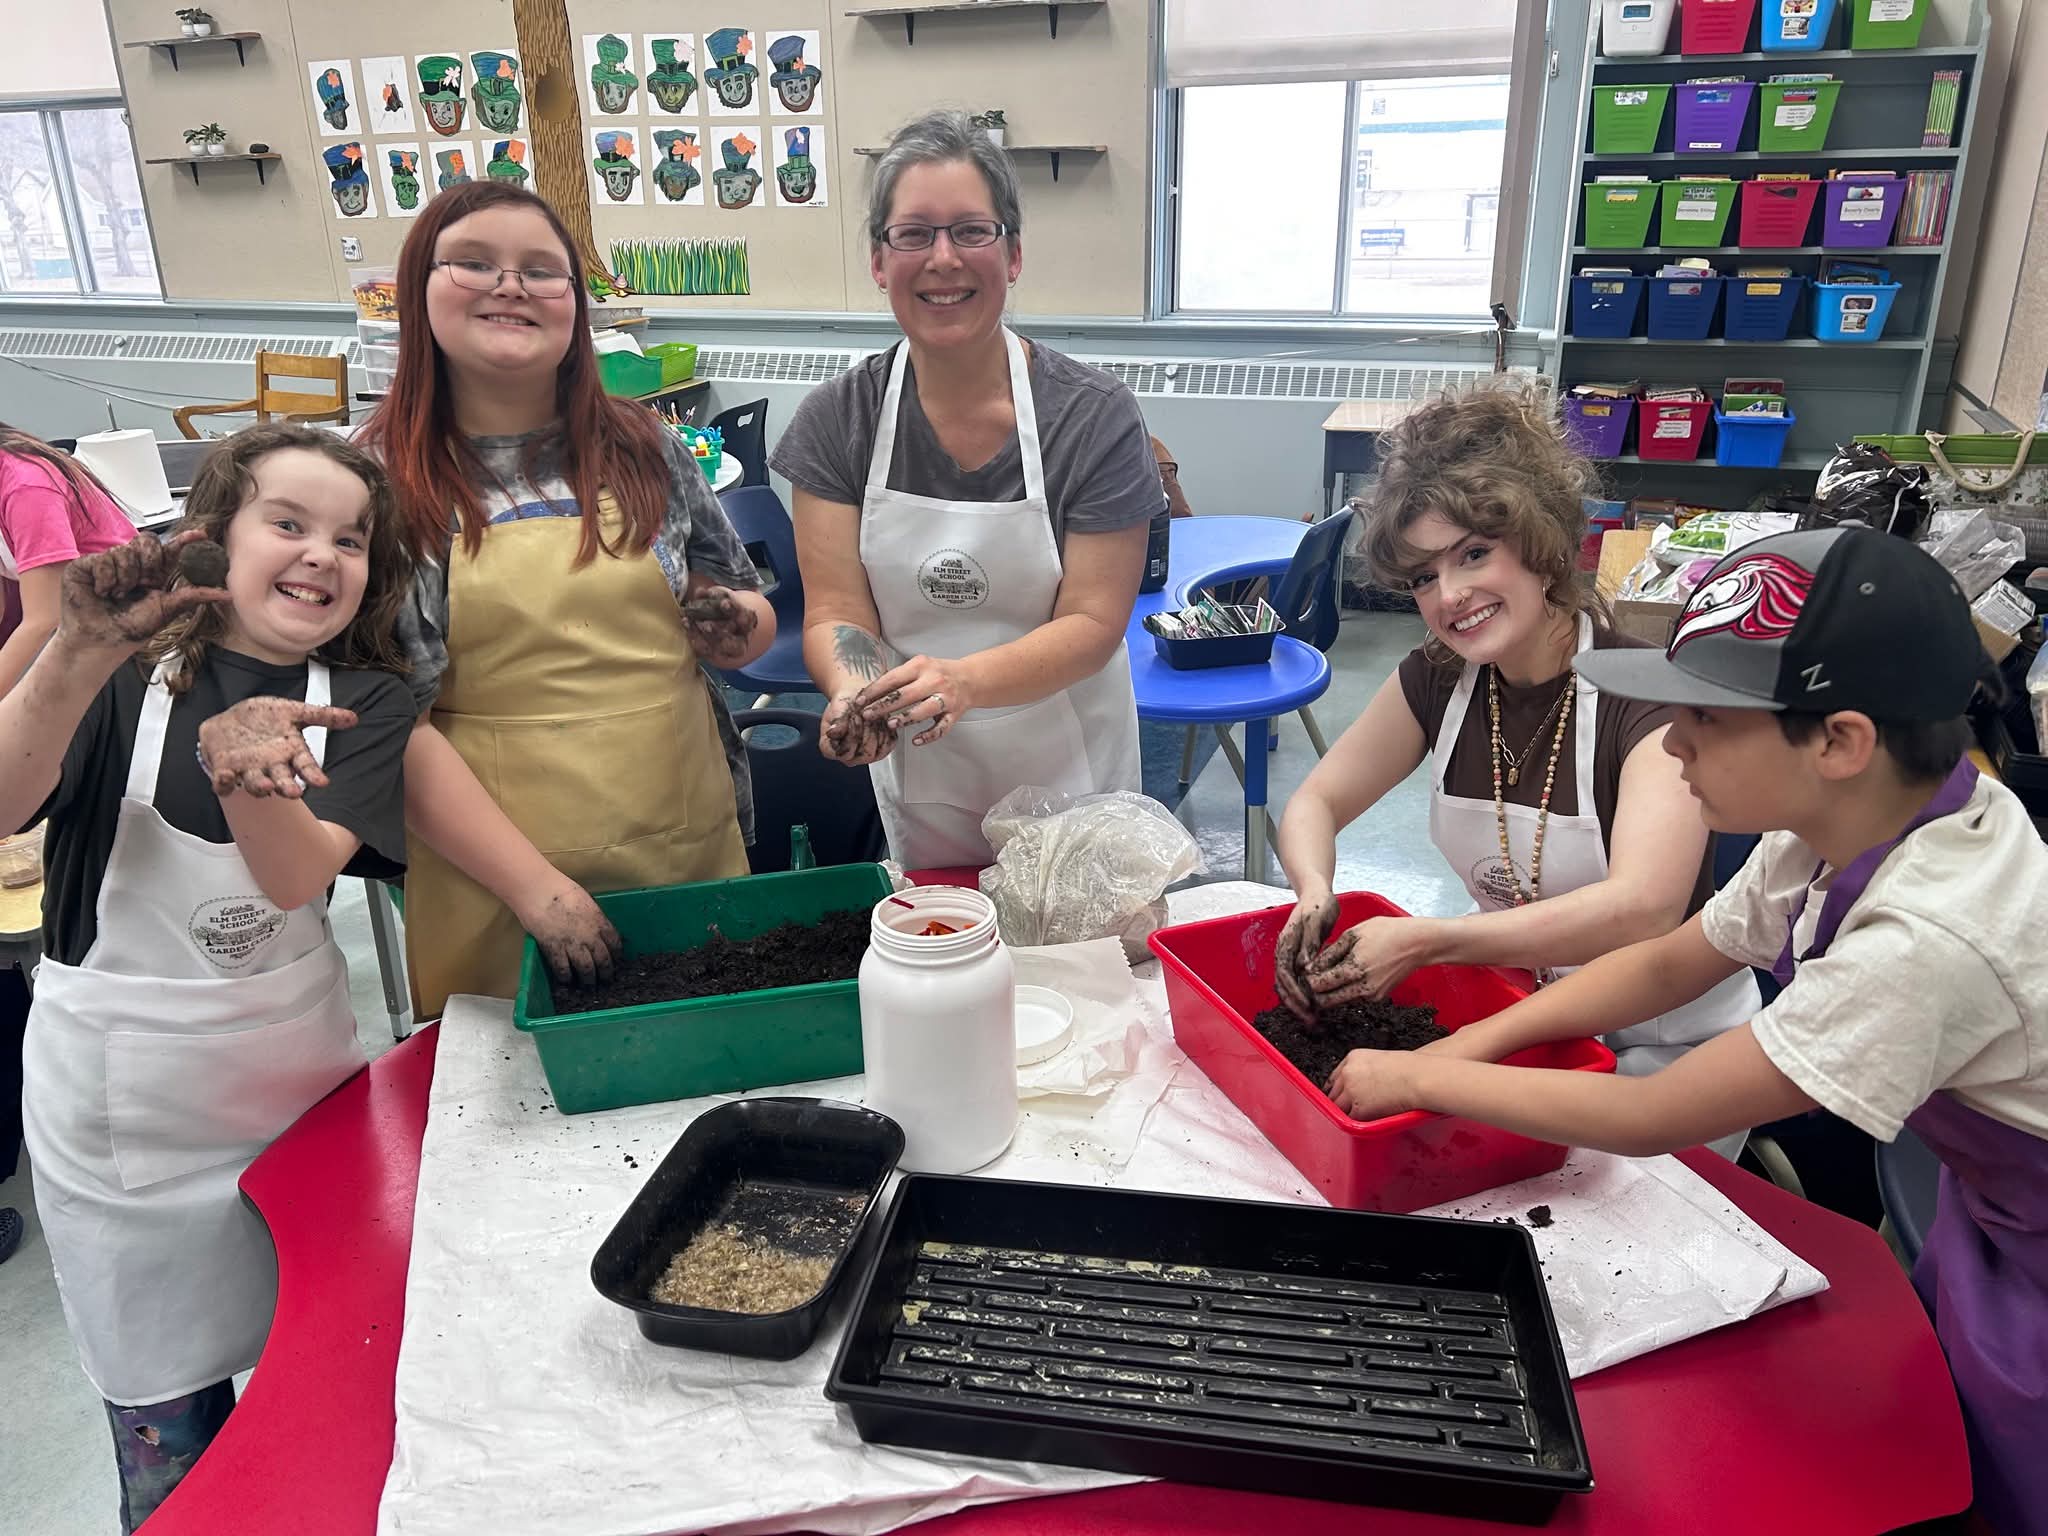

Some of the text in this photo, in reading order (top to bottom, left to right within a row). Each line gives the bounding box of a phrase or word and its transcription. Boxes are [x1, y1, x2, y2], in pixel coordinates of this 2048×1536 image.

[231, 908, 266, 921] STREET
[219, 917, 259, 930] SCHOOL
[208, 944, 249, 954] GARDEN
[250, 933, 272, 947] CLUB
